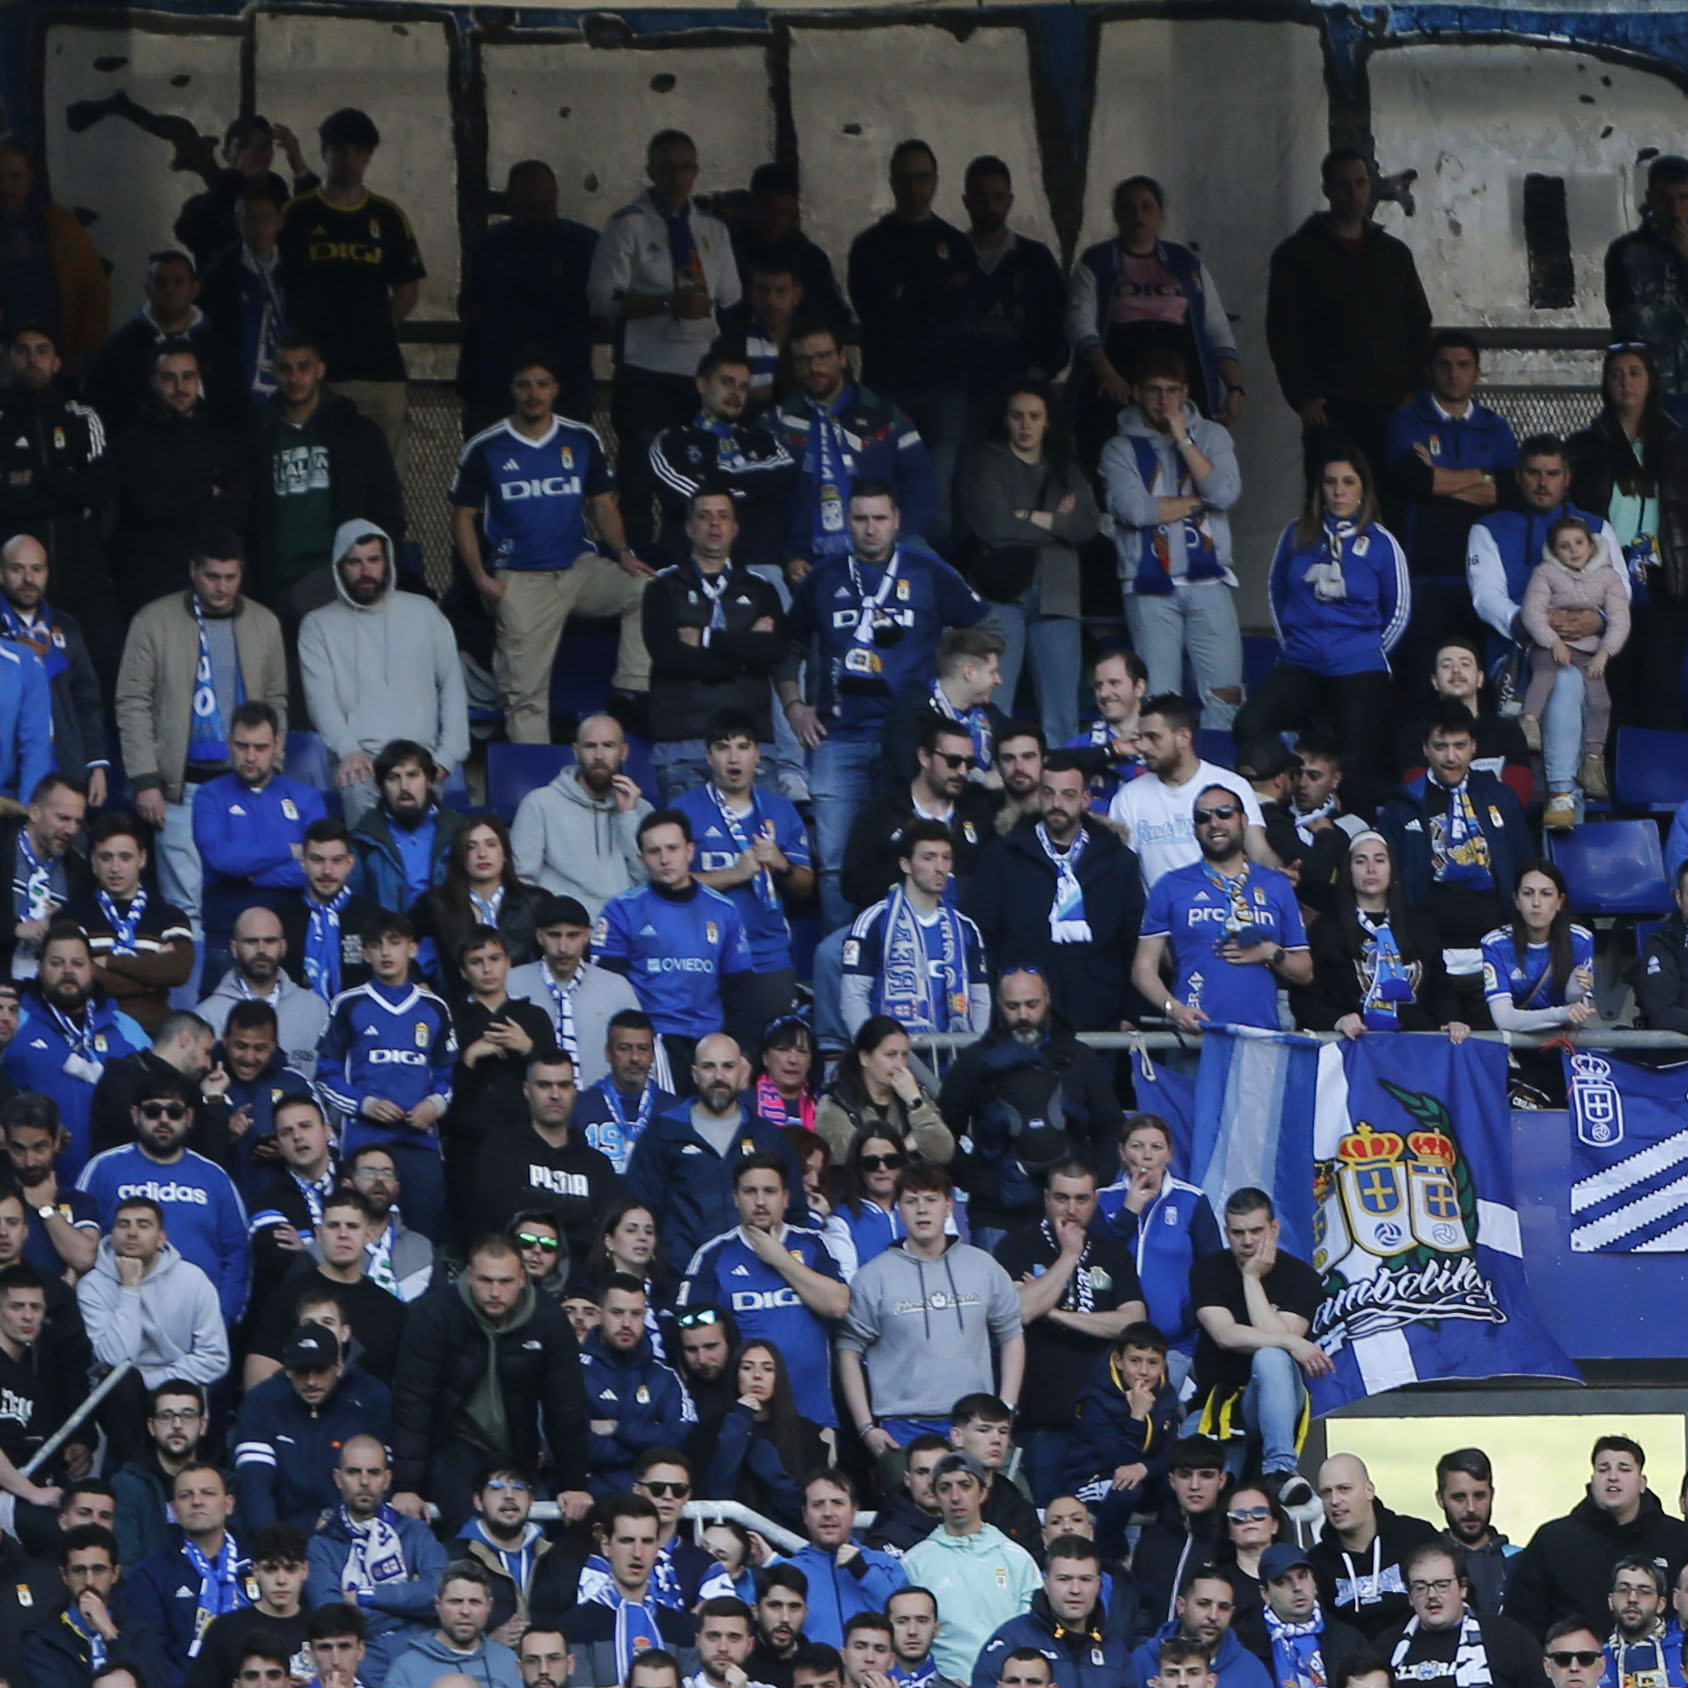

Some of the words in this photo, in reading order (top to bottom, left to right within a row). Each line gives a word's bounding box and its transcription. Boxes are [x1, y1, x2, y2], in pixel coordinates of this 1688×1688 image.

[310, 243, 382, 263] DIGI
[500, 476, 582, 501] DIGI
[117, 1179, 208, 1206] adidas
